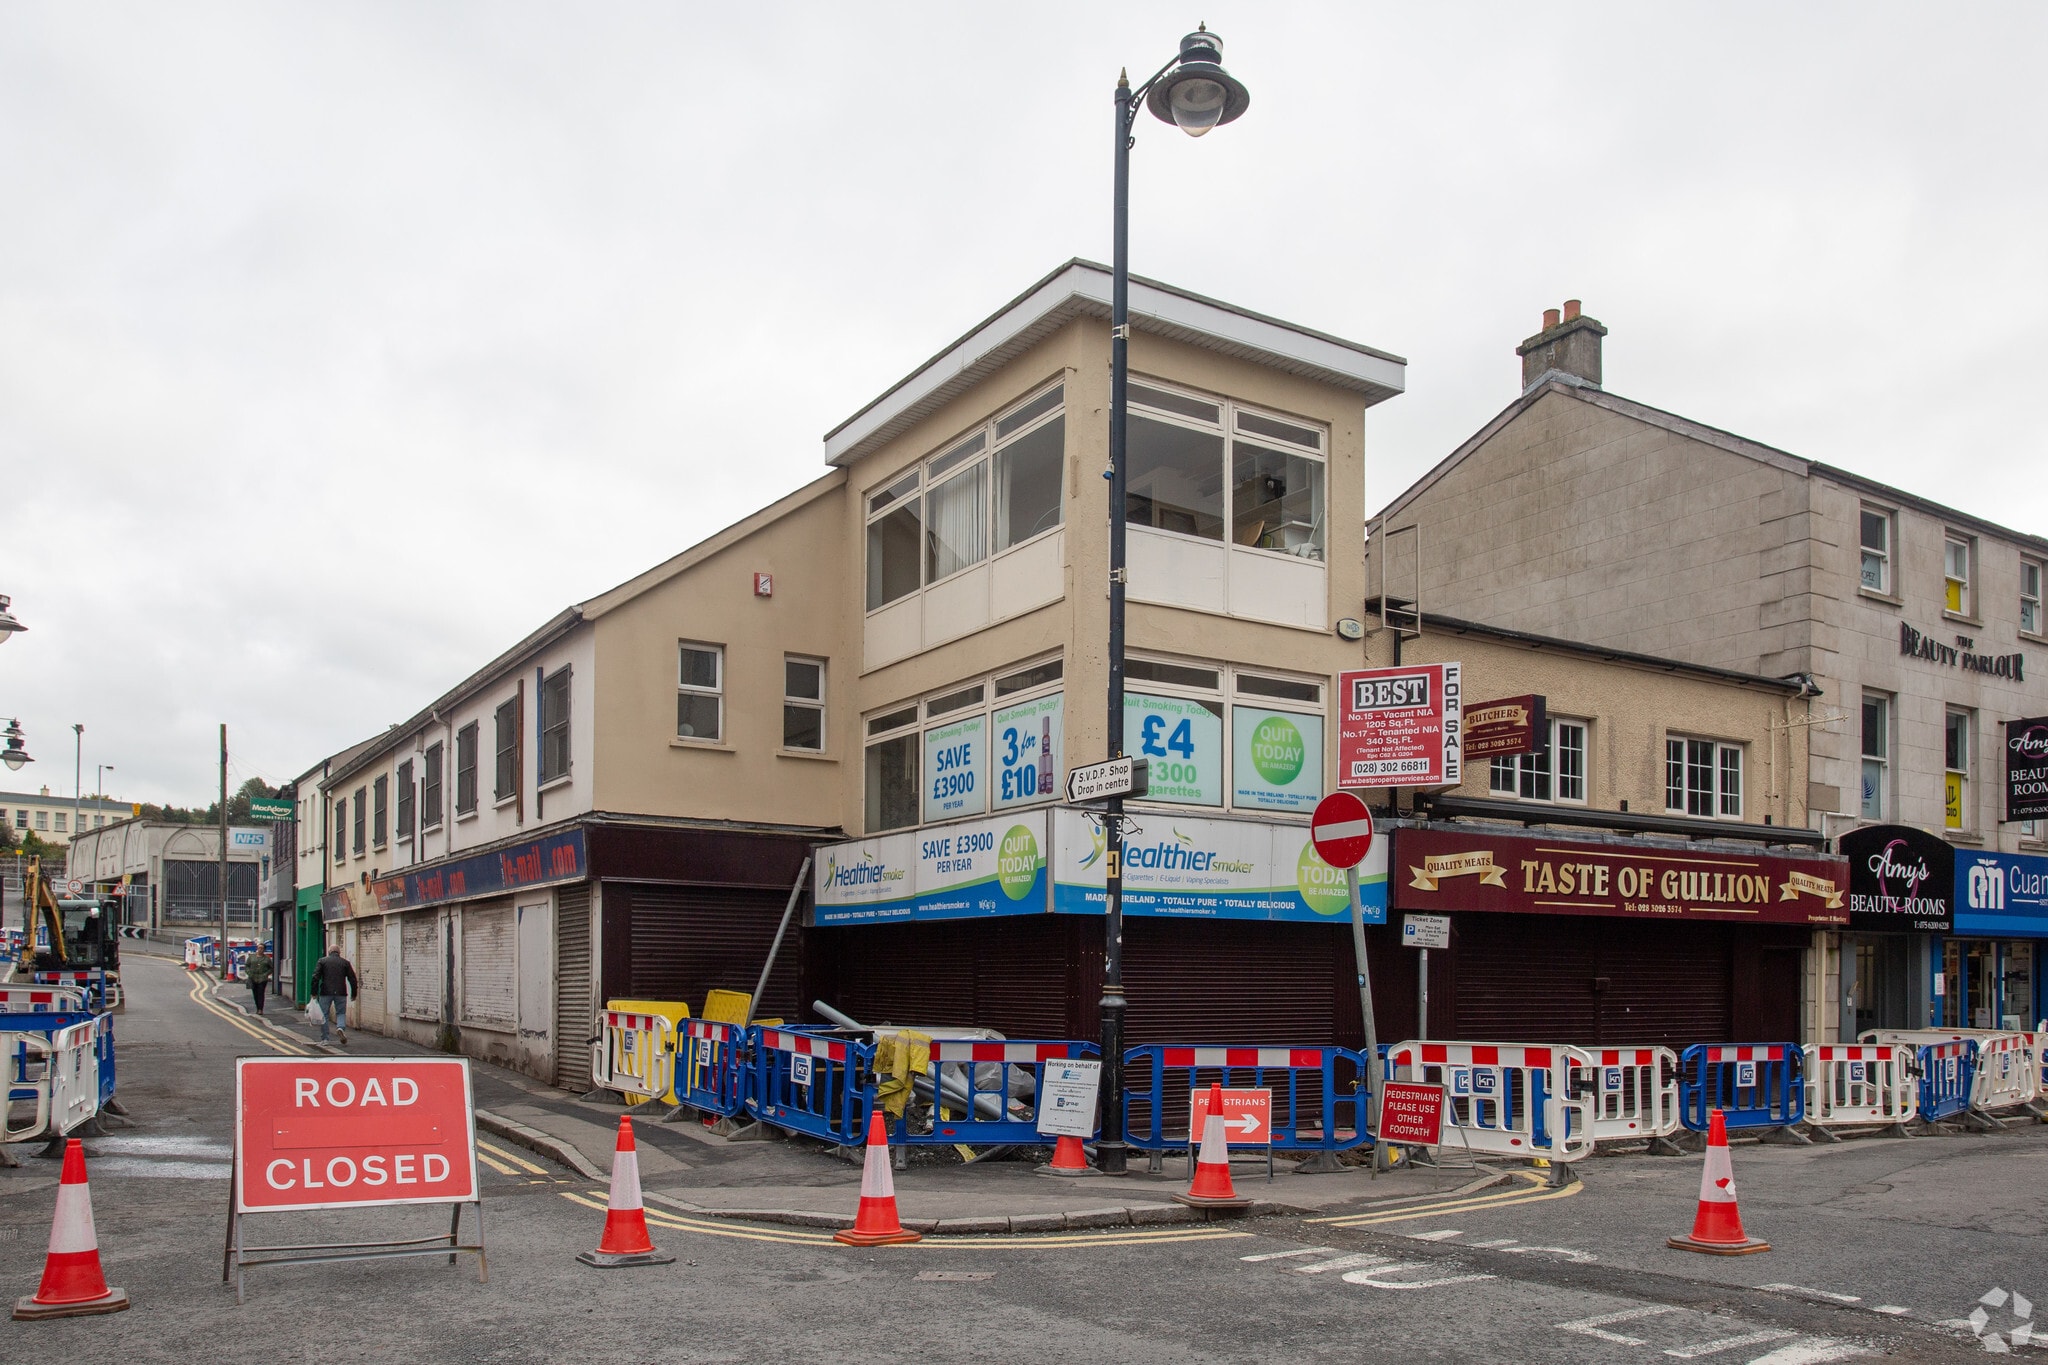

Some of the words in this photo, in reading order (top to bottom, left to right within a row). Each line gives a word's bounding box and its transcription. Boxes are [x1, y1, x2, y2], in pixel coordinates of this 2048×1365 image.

[1957, 635, 1974, 649] THE
[1901, 621, 1958, 667] BEAUTY
[1962, 652, 2025, 682] PARLOUR
[1359, 679, 1423, 706] BEST
[1445, 668, 1459, 712] FOR
[998, 712, 1010, 724] Quit
[1011, 707, 1037, 722] Smoking
[1039, 699, 1059, 711] Today!
[1143, 699, 1183, 715] Smoking
[1349, 713, 1373, 721] No.15
[1384, 711, 1414, 719] Vacant
[1417, 708, 1434, 716] NIA
[1470, 709, 1519, 724] BUTCHERS
[929, 732, 939, 743] Quit
[940, 727, 962, 741] Smoking
[963, 720, 981, 733] Today!
[1142, 715, 1195, 760] £4
[1260, 725, 1294, 743] QUIT
[1343, 730, 1367, 738] No.17
[1378, 727, 1419, 736] Tenanted
[1002, 727, 1019, 767] 3
[1020, 730, 1037, 758] for
[1357, 746, 1380, 754] (Tenant
[1444, 720, 1459, 779] SALE
[2009, 732, 2048, 754] Amy
[937, 743, 971, 772] SAVE
[1255, 744, 1302, 762] TODAY
[1079, 768, 1107, 783] S.V.D.P.
[1110, 765, 1129, 776] Shop
[1262, 761, 1268, 769] BE
[1270, 762, 1296, 771] AMAZED!
[1355, 762, 1377, 775] (028)
[1381, 762, 1398, 772] 302
[1401, 761, 1427, 771] 66811
[2011, 767, 2048, 782] BEAUT
[934, 771, 975, 800] £3900
[1002, 764, 1036, 801] £10
[1078, 786, 1094, 795] Drop
[1097, 782, 1103, 792] in
[1105, 778, 1129, 790] centre
[1342, 775, 1439, 785] www.bestpropertyservices.com
[1148, 785, 1202, 798] garettes
[2014, 782, 2048, 796] ROOM
[252, 804, 293, 815] MacAdorey
[943, 802, 952, 811] PER
[952, 800, 964, 809] YEAR
[236, 834, 263, 844] NHS
[923, 838, 951, 860] SAVE
[957, 831, 994, 854] £3900
[1005, 835, 1030, 855] QUIT
[549, 844, 577, 877] .com
[937, 860, 951, 874] PER
[951, 858, 972, 872] YEAR
[1000, 855, 1036, 874] TODAY
[1122, 841, 1216, 871] ealthier
[1211, 859, 1255, 875] smoker
[1428, 860, 1463, 873] QUALITY
[1465, 857, 1491, 868] MEATS
[834, 861, 885, 888] Healthier
[883, 869, 905, 884] smoker
[1301, 866, 1347, 885] TODA
[1868, 848, 1930, 888] Amy's
[1160, 875, 1180, 883] E-Liquid
[1186, 876, 1204, 885] Vaping
[1204, 877, 1230, 886] Specialists
[1521, 859, 1610, 896] TASTE
[1618, 867, 1654, 898] OF
[1661, 870, 1770, 904] GULLION
[1791, 877, 1815, 890] QUALITY
[1816, 884, 1833, 894] MEATS
[1318, 888, 1349, 897] AMAZED!
[1122, 895, 1156, 904] IRELAND
[1163, 897, 1196, 906] TOTALLY
[1197, 898, 1217, 907] PURE
[1224, 899, 1256, 908] TOTALLY
[1257, 900, 1296, 910] DELICIOUS
[1155, 907, 1216, 915] www.healthiersmoker.ie
[1624, 903, 1637, 912] Tel:
[1638, 904, 1650, 912] 028
[1651, 904, 1666, 913] 3026
[1667, 905, 1682, 914] 3574
[1850, 894, 1901, 913] BEAUTY
[1904, 897, 1945, 916] ROOMS
[1408, 926, 1414, 934] P
[295, 1077, 419, 1108] ROAD
[1386, 1090, 1440, 1103] PEDESTRIANS
[1198, 1098, 1266, 1106] PESTRIANS
[1388, 1102, 1417, 1112] PLEASE
[1419, 1104, 1436, 1114] USE
[1397, 1114, 1424, 1125] OTHER
[1390, 1124, 1430, 1137] FOOTPATH
[266, 1154, 450, 1190] CLOSED
